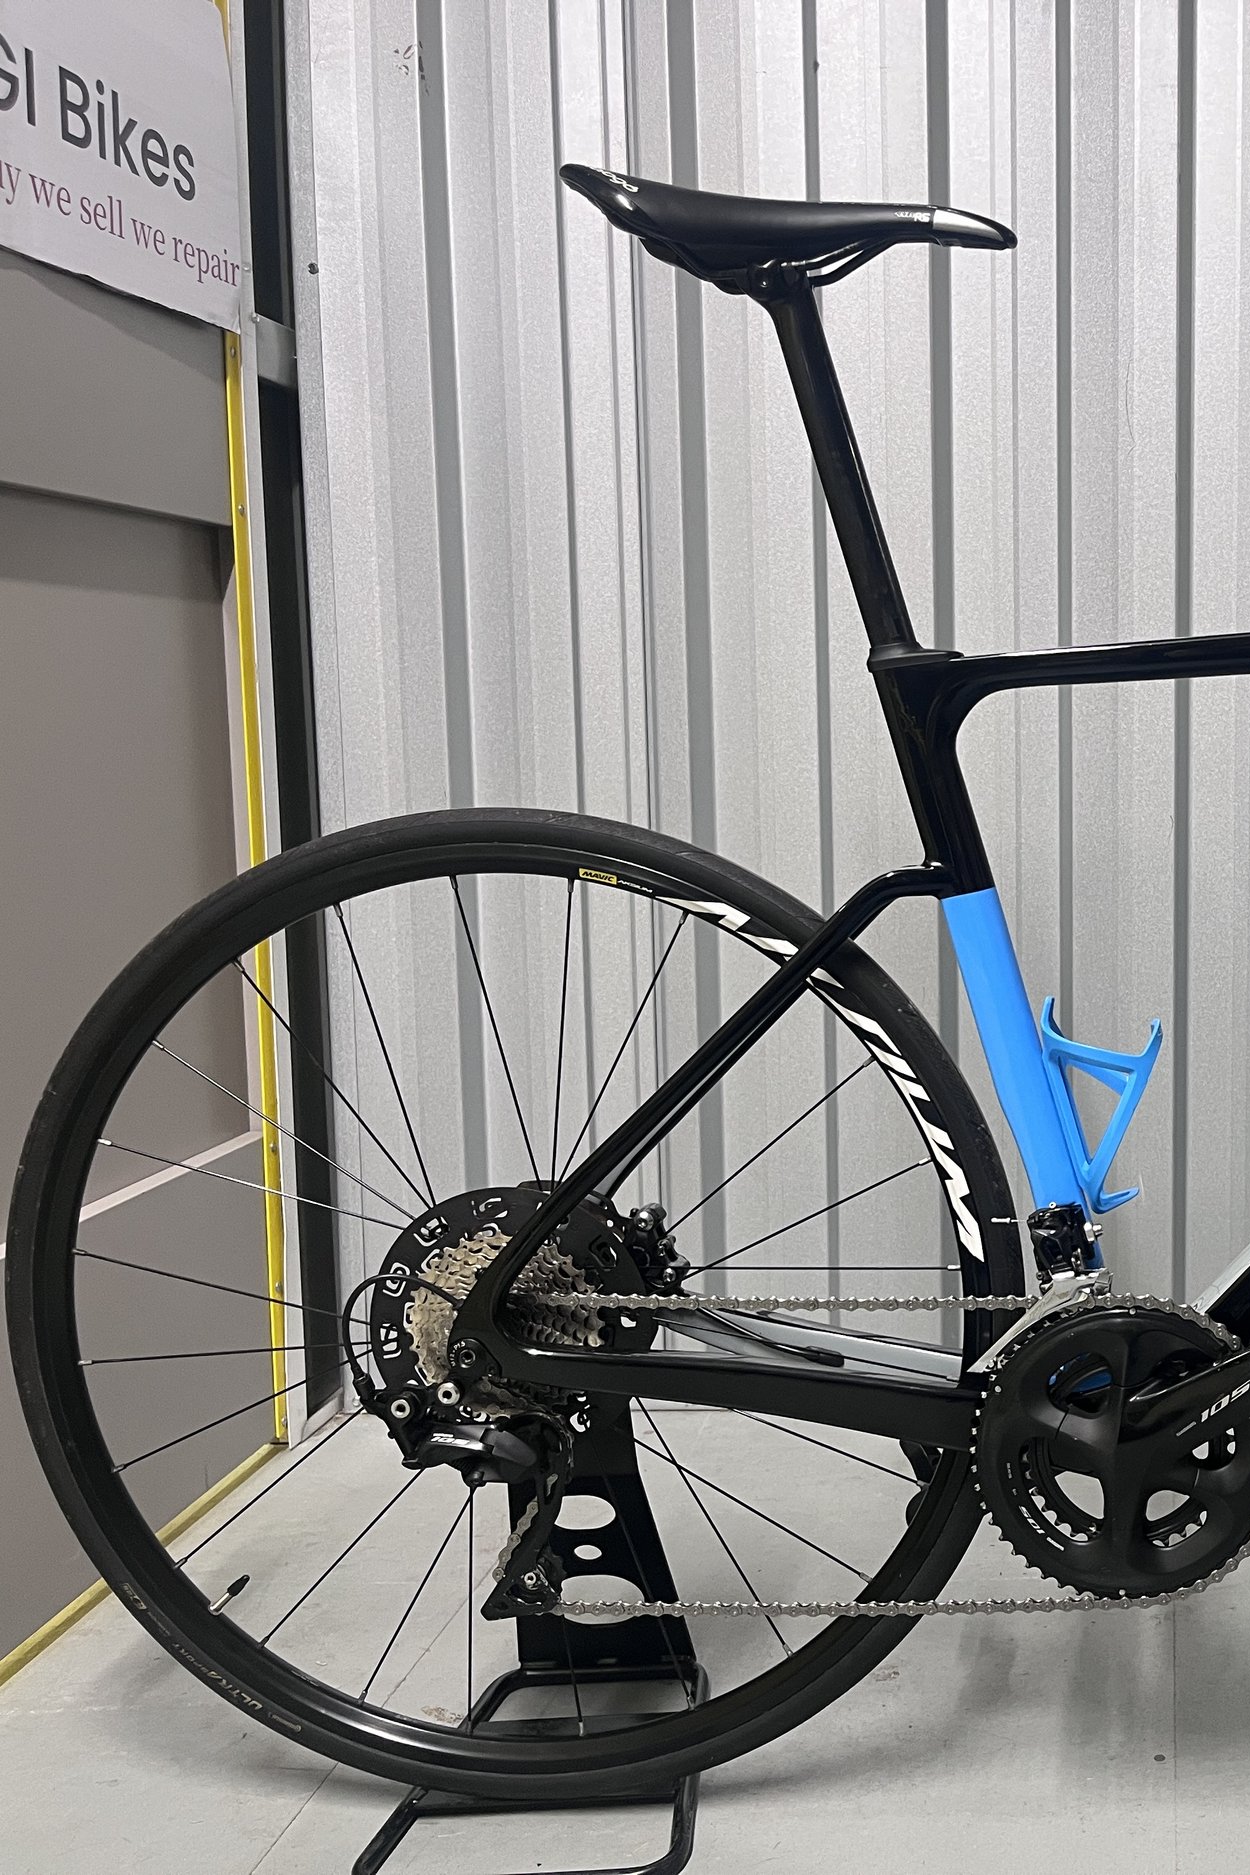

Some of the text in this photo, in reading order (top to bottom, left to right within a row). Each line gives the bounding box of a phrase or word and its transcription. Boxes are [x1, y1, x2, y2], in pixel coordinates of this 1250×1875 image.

[58, 64, 196, 202] Bikes
[28, 173, 71, 216] we
[80, 195, 125, 240] sell
[130, 217, 166, 256] we
[172, 236, 240, 287] repair
[580, 870, 615, 884] MAVIC
[1018, 1505, 1046, 1535] 105
